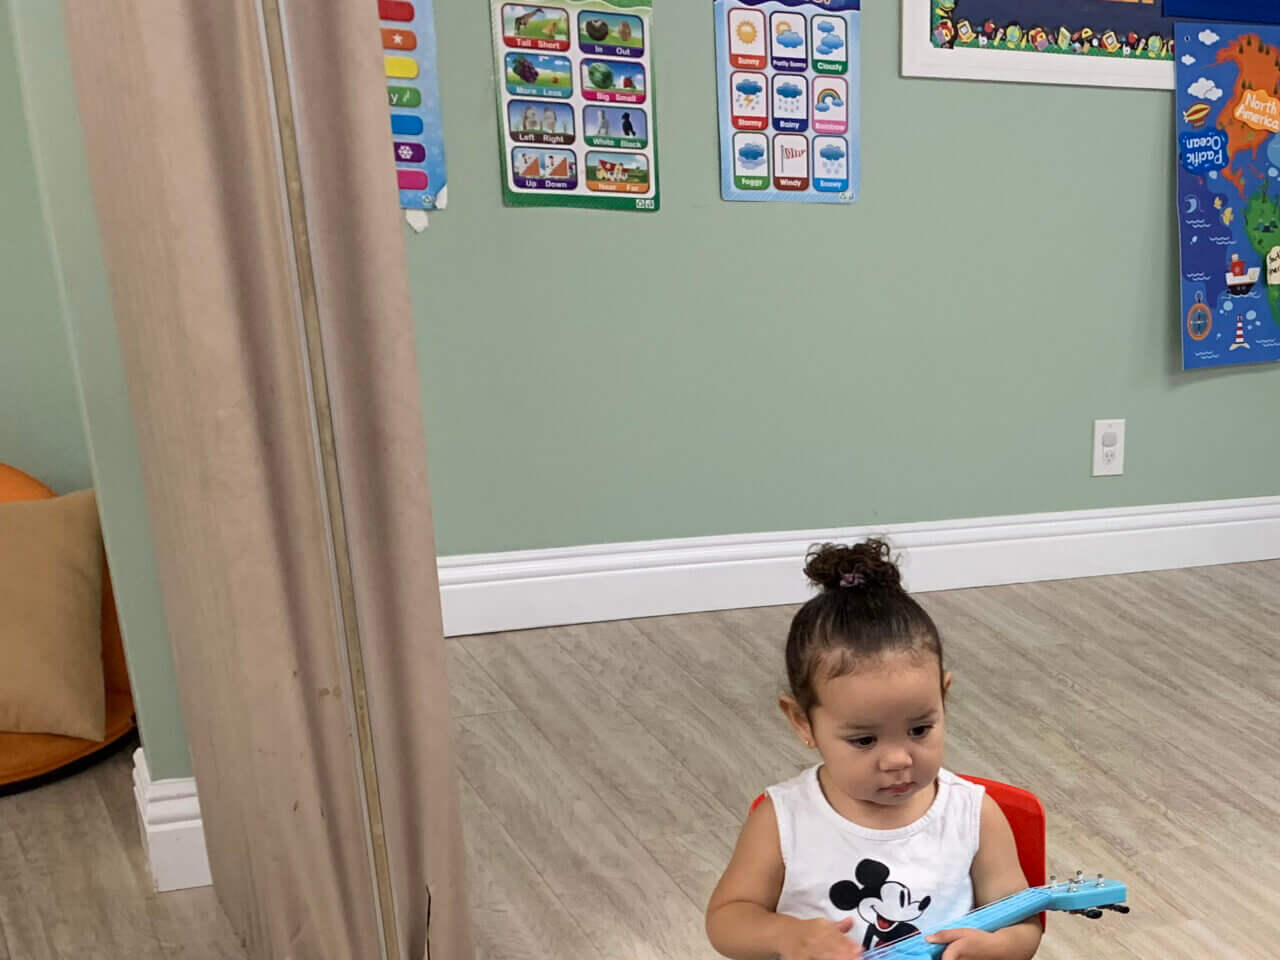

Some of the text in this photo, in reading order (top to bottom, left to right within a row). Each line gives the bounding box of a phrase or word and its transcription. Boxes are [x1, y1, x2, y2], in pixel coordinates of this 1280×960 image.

[516, 38, 560, 49] Tall Short
[595, 45, 630, 56] In Out
[737, 57, 760, 66] Sunny
[817, 62, 842, 72] Cloudy
[516, 86, 562, 96] More Less
[596, 92, 637, 102] Big Small
[1244, 92, 1278, 115] North
[1236, 104, 1280, 130] America
[738, 118, 762, 128] Stormy
[780, 120, 799, 129] Rainy
[815, 122, 845, 131] Rainbow
[519, 133, 564, 144] Left Right
[593, 138, 643, 148] White Black
[1186, 135, 1222, 151] Ocean
[1186, 150, 1223, 167] Pacific
[526, 180, 567, 188] Up Down
[599, 183, 616, 191] Near
[741, 178, 762, 187] Foggy
[779, 179, 802, 187] Windy
[820, 180, 843, 189] Snowy
